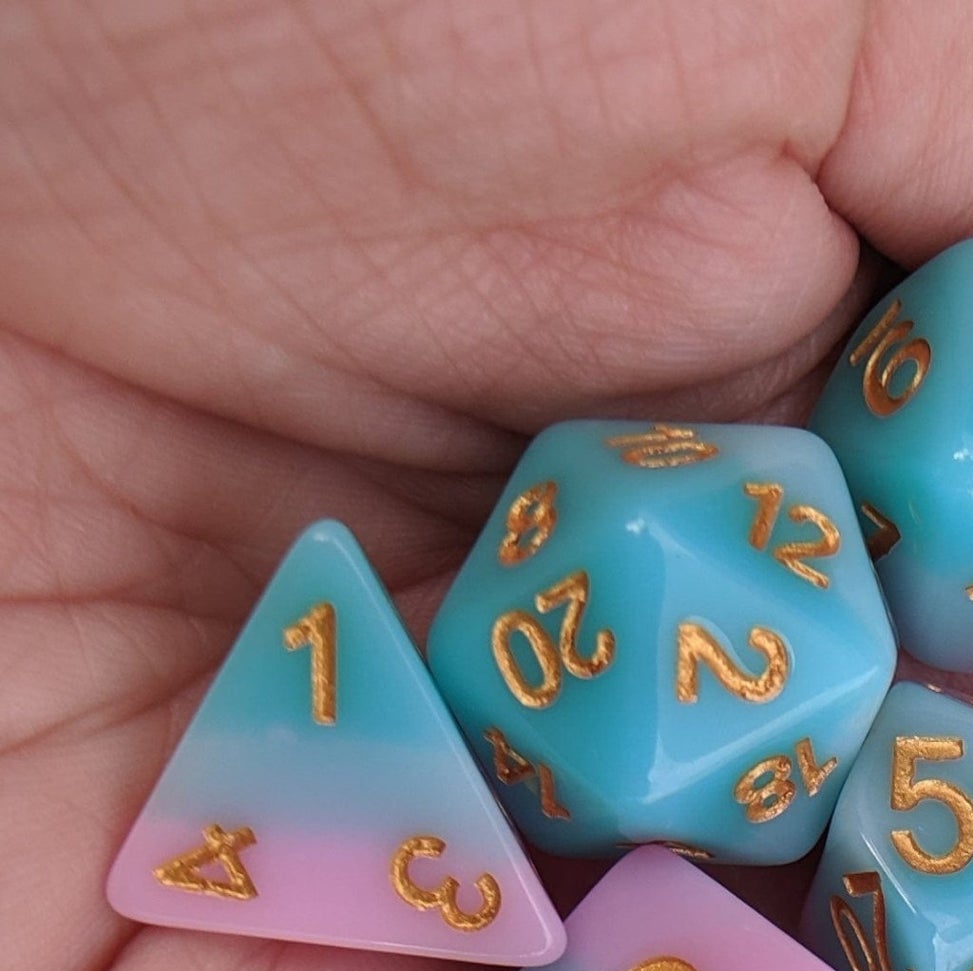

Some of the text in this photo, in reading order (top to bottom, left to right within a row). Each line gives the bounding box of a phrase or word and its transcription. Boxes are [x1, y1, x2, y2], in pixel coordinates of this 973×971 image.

[498, 480, 558, 567] 8
[743, 481, 841, 589] 12
[283, 601, 337, 726] 1
[491, 570, 616, 709] 20
[674, 621, 790, 703] 2
[734, 738, 838, 824] 18
[153, 823, 259, 901] 4
[389, 835, 502, 932] 3
